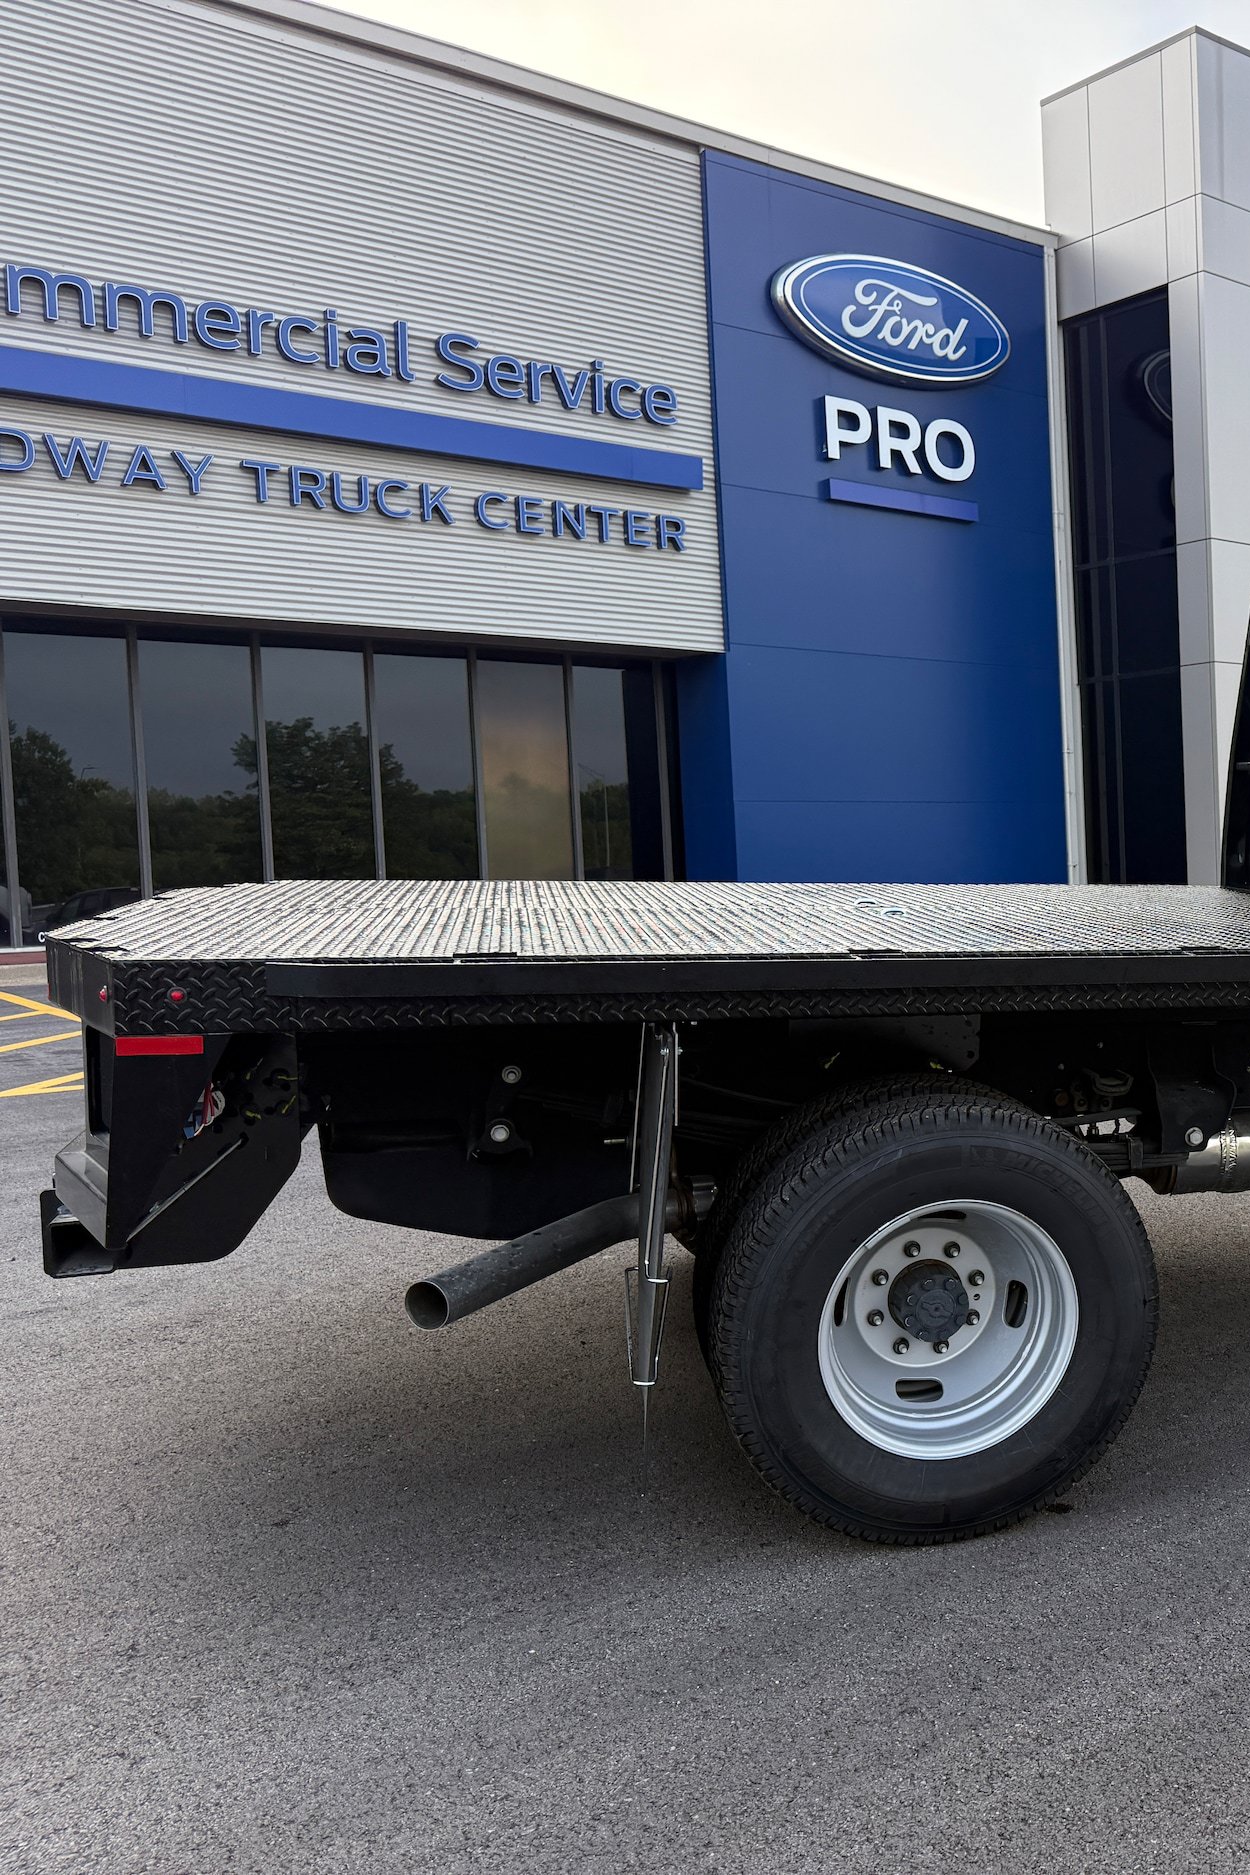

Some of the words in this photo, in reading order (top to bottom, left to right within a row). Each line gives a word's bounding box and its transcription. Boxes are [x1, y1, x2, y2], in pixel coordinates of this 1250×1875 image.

[5, 263, 416, 382] mmercial
[434, 332, 679, 426] Service
[841, 278, 969, 361] Ford
[824, 394, 976, 482] PRO
[240, 458, 455, 524] TRUCK
[474, 491, 688, 551] CENTER
